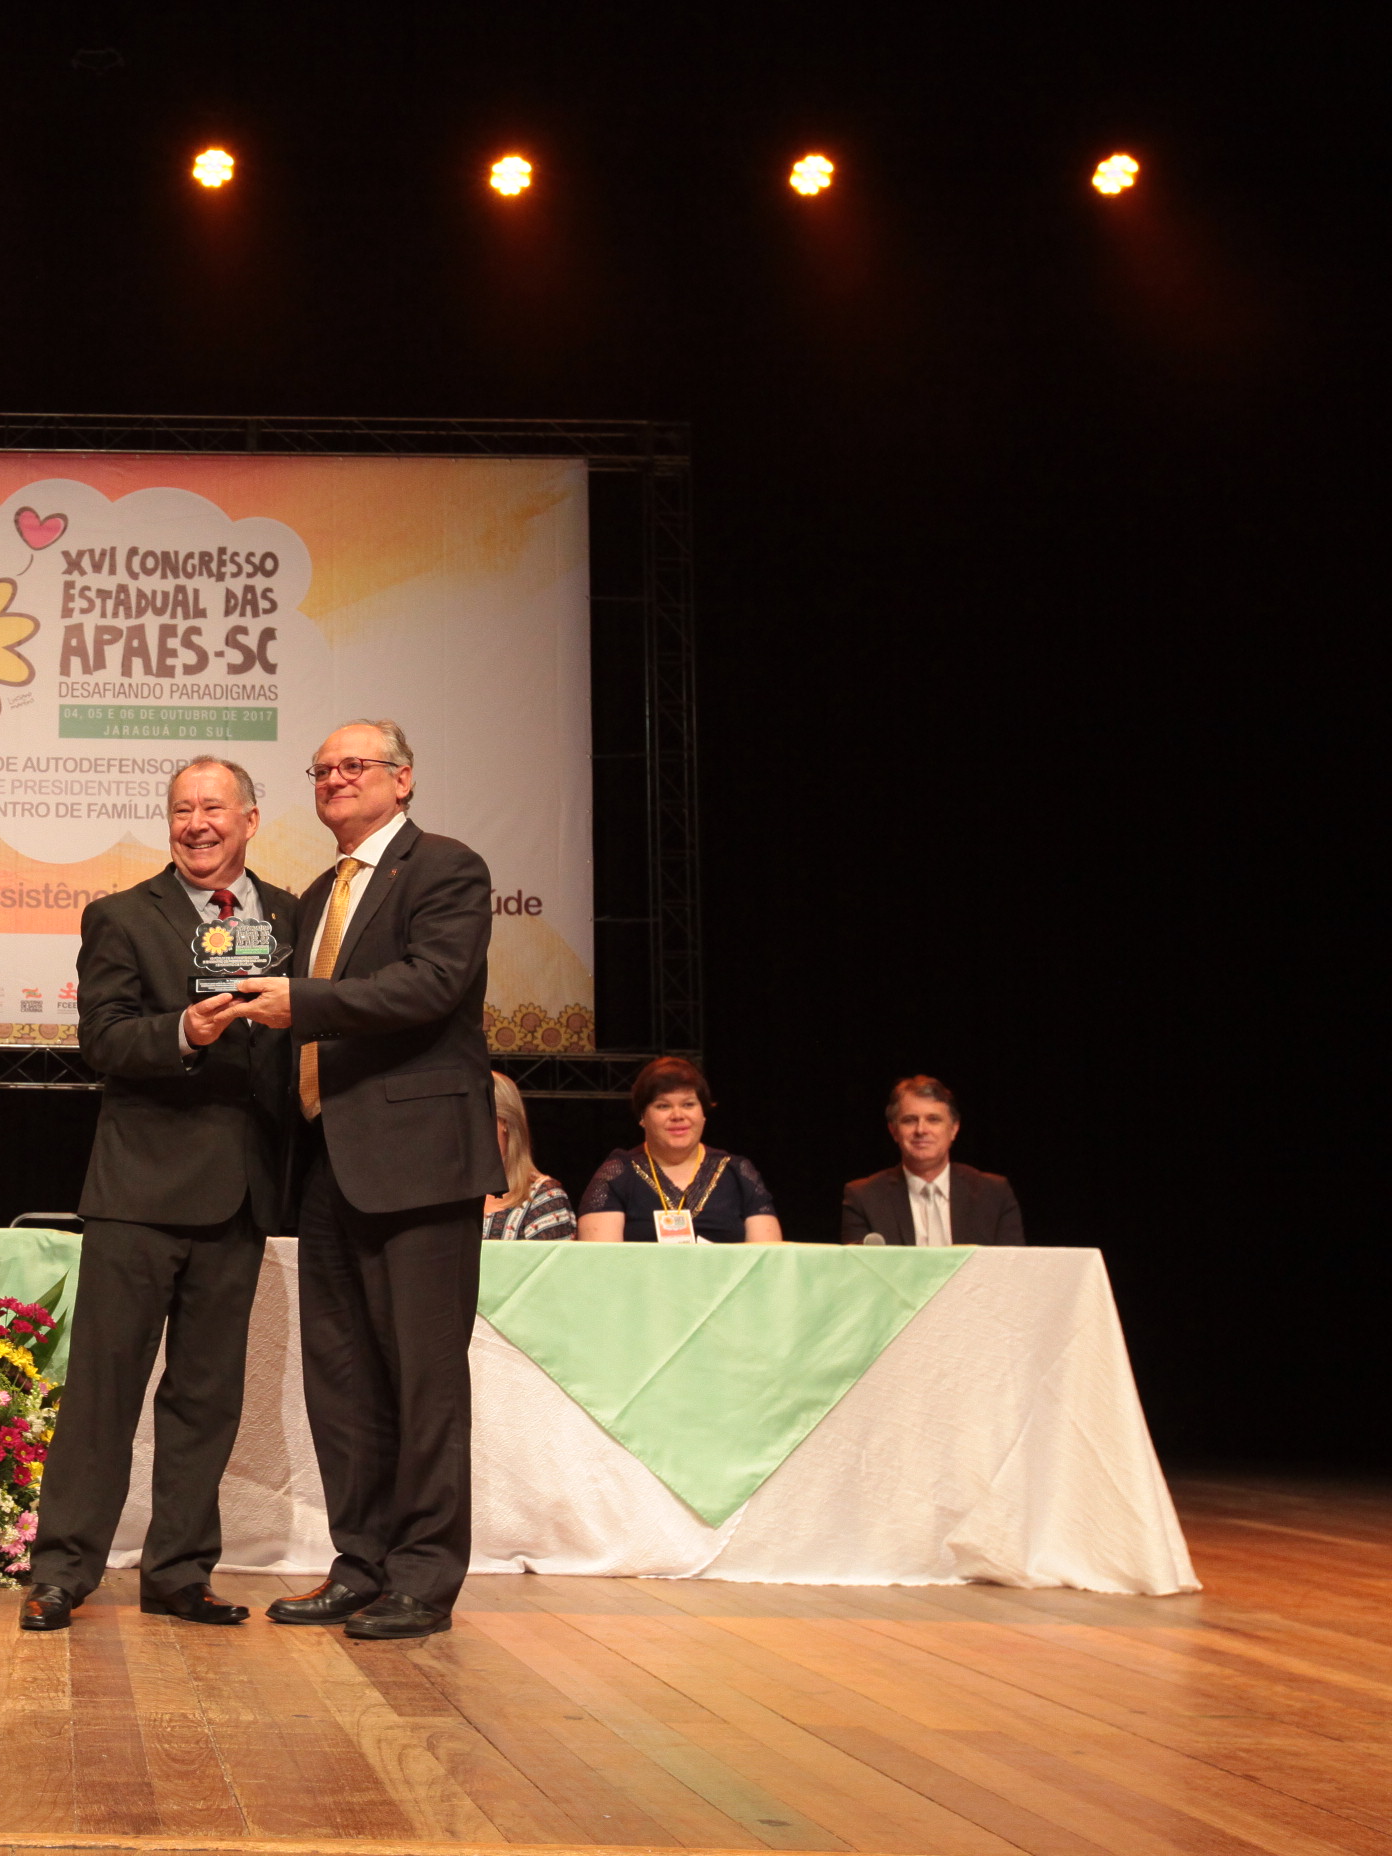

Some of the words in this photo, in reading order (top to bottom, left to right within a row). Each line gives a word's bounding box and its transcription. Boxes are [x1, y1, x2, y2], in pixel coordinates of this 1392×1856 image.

[61, 546, 117, 577] XVI
[125, 546, 279, 582] CONGRESSO
[60, 580, 208, 620] ESTADUAL
[224, 584, 278, 618] DAS
[60, 622, 278, 679] APAES-SC
[58, 681, 164, 699] DESAFIANDO
[170, 683, 279, 701] PARADIGMAS
[64, 708, 83, 721] 04,
[88, 708, 103, 720] 05
[108, 709, 115, 720] E
[120, 709, 135, 720] 06
[140, 709, 155, 720] DE
[160, 709, 217, 721] OUTUBRO
[222, 710, 237, 721] DE
[243, 710, 273, 722] 2017
[104, 723, 170, 737] JARAGUÁ
[179, 725, 197, 737] DO
[206, 726, 233, 738] SUL
[22, 757, 193, 775] AUTODEFENSOR
[11, 779, 151, 797] PRESIDENTES
[55, 802, 83, 818] DE
[87, 800, 169, 820] FAMÍLIA
